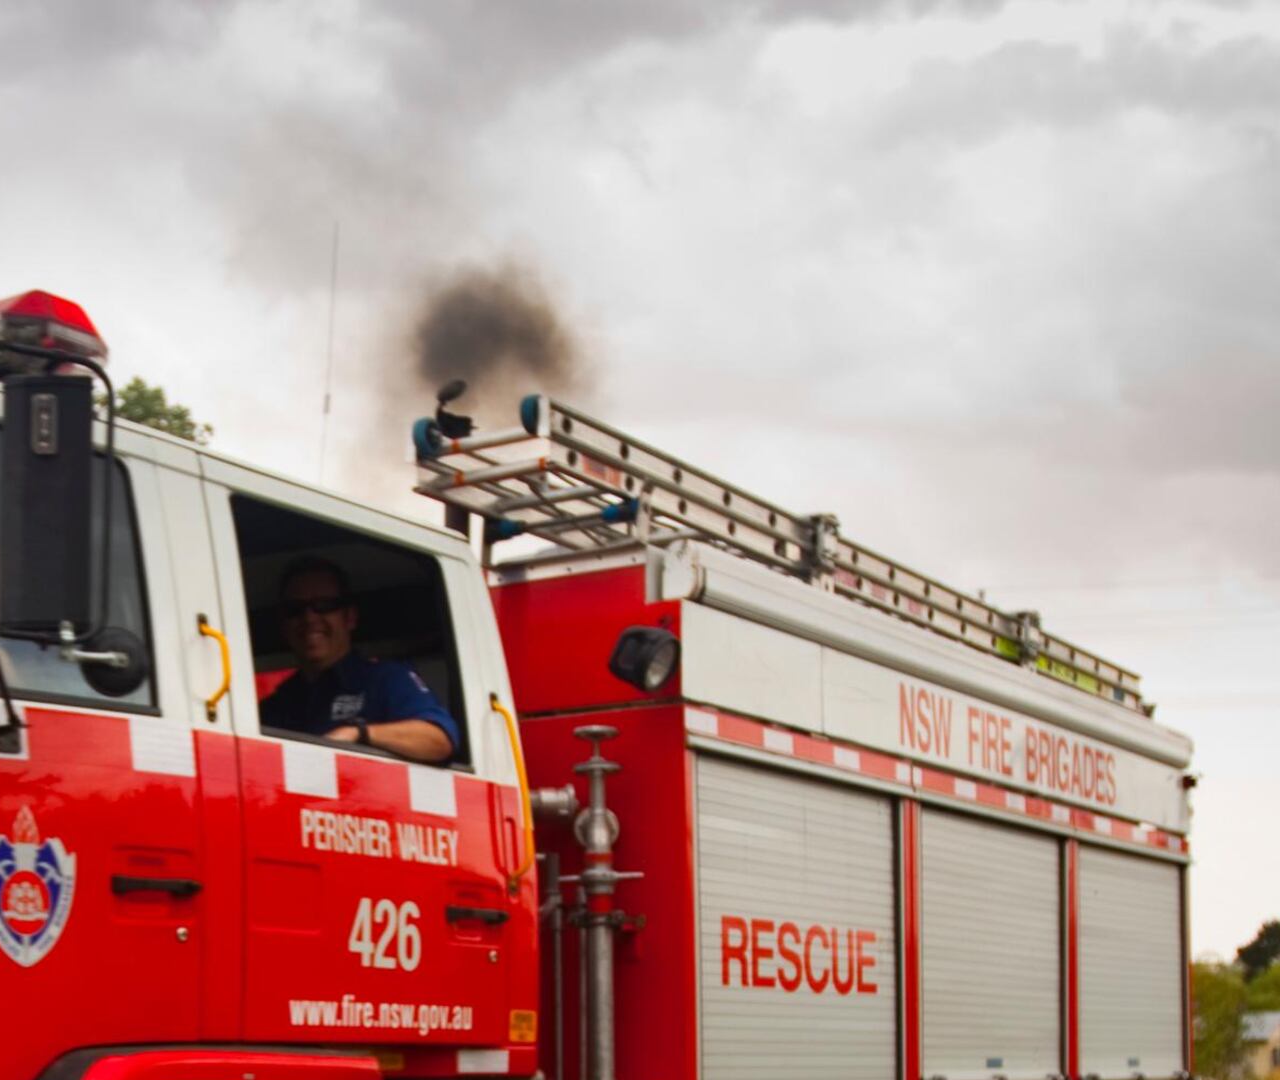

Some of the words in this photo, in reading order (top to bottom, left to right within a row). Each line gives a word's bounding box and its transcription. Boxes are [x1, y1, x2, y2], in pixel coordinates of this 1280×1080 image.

[898, 682, 952, 760] NSW
[967, 706, 1013, 776] FIRE
[1024, 726, 1117, 807] BRIGADES
[300, 808, 392, 859] PERISHER
[395, 822, 459, 867] VALLEY
[348, 897, 421, 972] 426
[720, 915, 878, 997] RESCUE
[289, 994, 473, 1036] www.fire.nsw.gov.au
